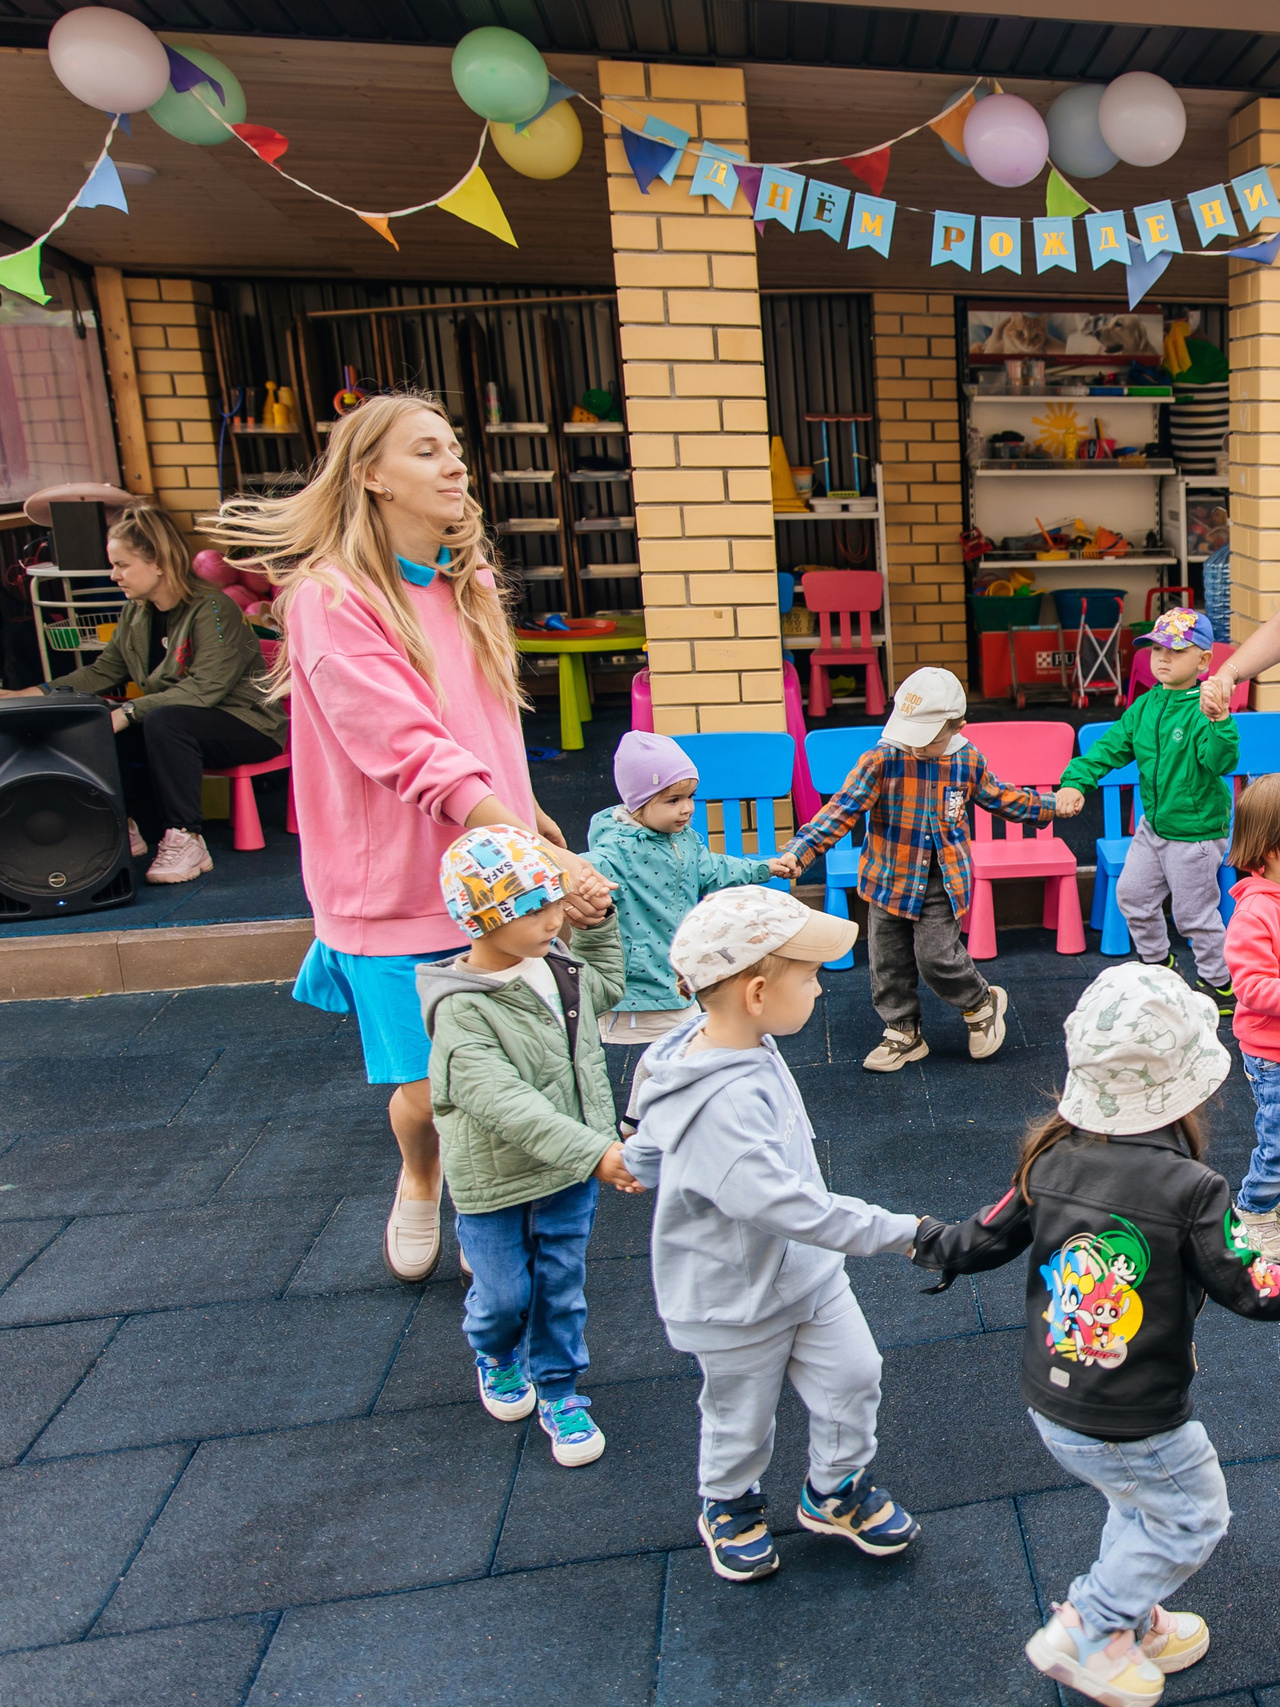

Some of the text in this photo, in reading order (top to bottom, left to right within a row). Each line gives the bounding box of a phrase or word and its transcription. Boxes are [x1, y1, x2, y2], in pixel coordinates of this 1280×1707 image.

[703, 161, 885, 237] ДНЁМ
[904, 692, 923, 706] GOOD
[900, 703, 916, 715] DAY
